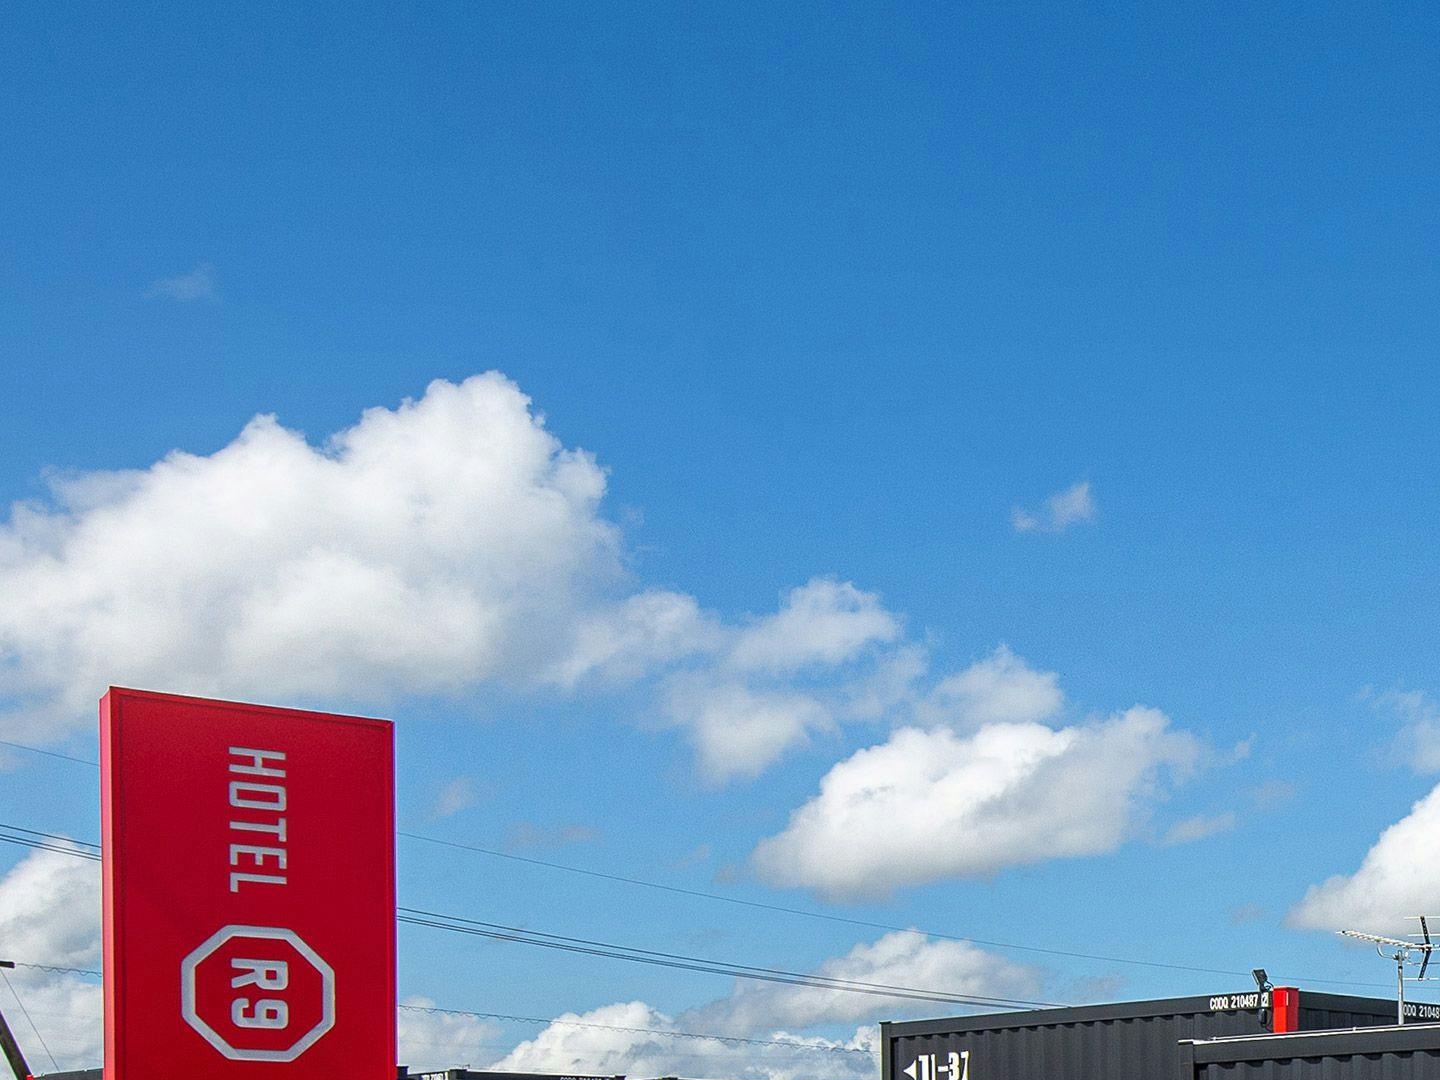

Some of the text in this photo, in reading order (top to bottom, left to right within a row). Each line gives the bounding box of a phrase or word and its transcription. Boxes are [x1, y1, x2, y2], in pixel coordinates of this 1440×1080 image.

[228, 746, 287, 893] HOTEL
[230, 958, 289, 1030] R9
[1209, 996, 1228, 1010] CODQ
[1231, 993, 1258, 1008] 210487
